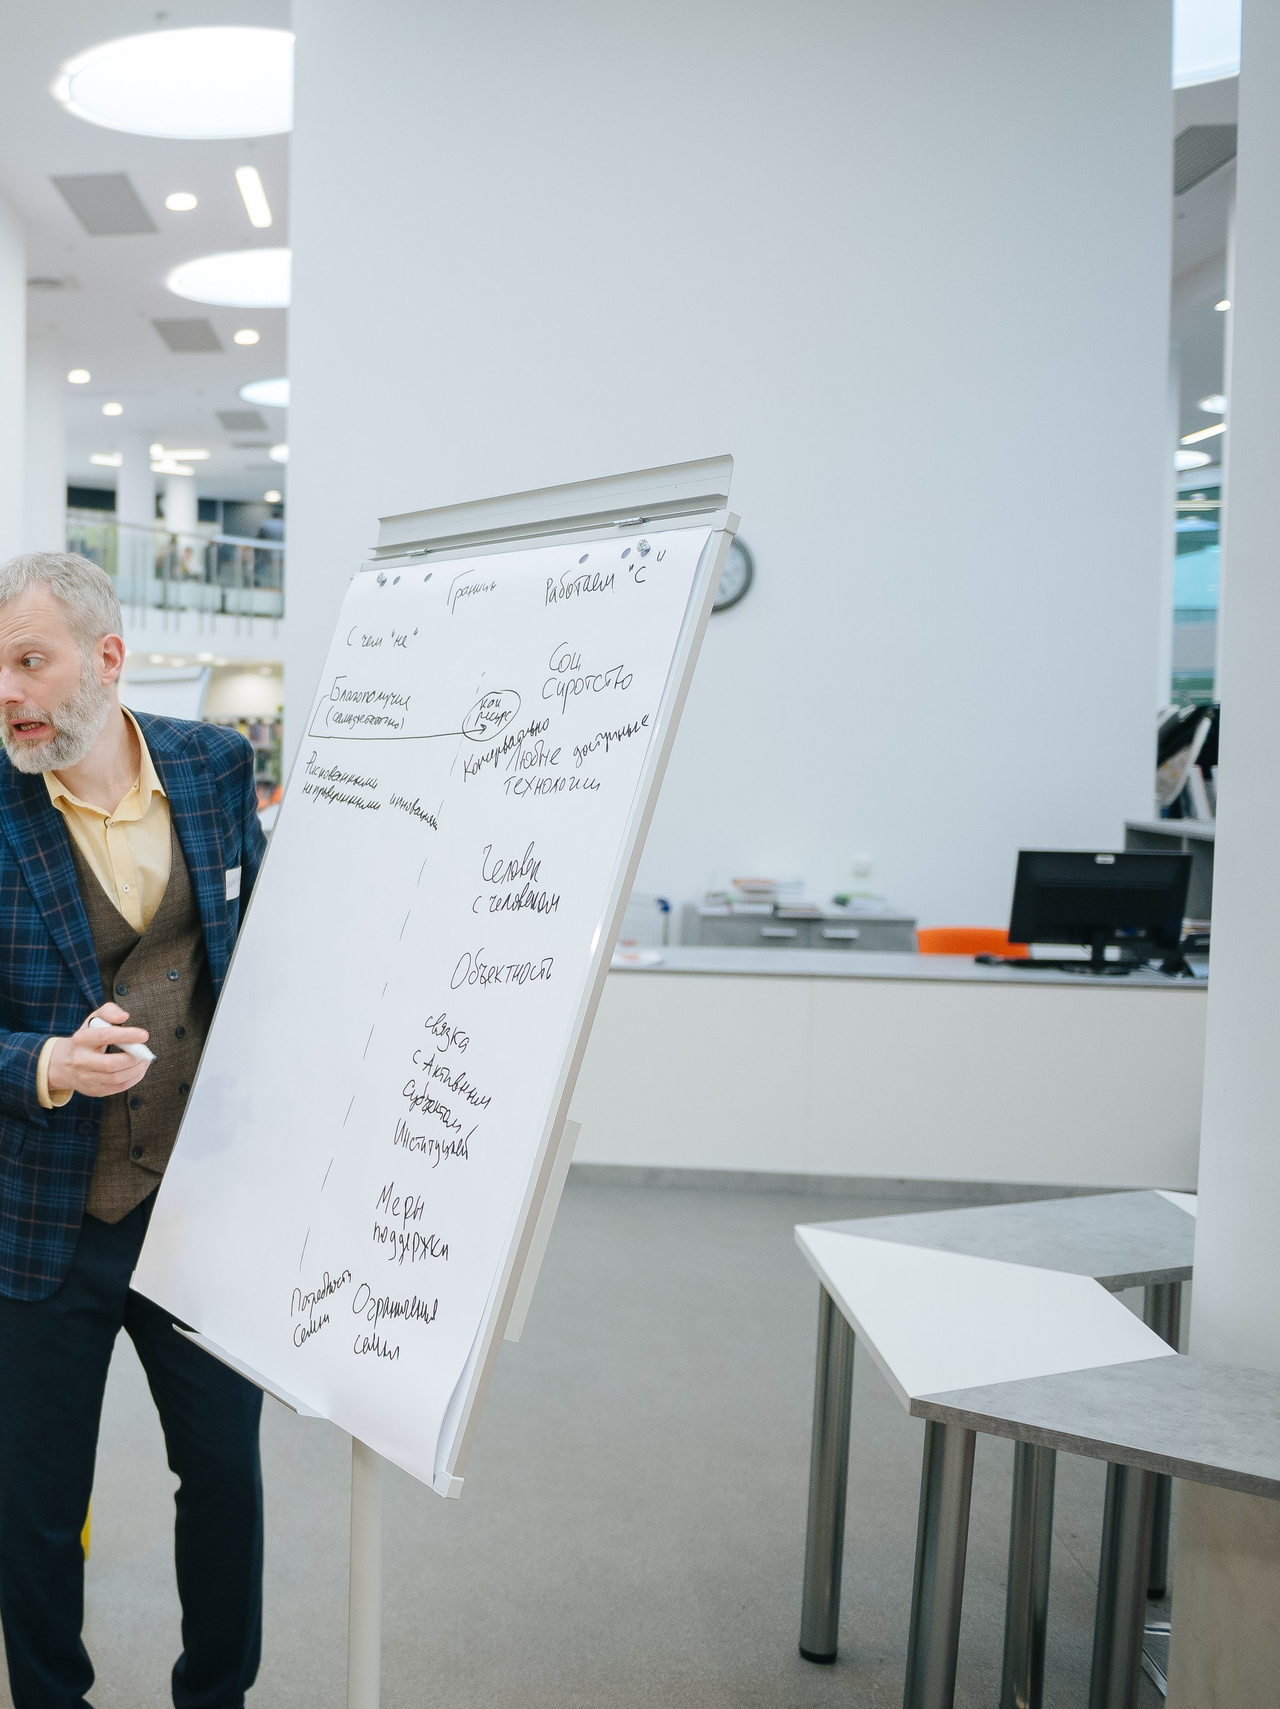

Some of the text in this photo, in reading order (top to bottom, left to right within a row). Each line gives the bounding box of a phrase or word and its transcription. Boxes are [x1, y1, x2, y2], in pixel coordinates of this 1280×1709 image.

[544, 569, 615, 607] Работаем
[361, 635, 384, 648] чем
[549, 641, 582, 674] Соц
